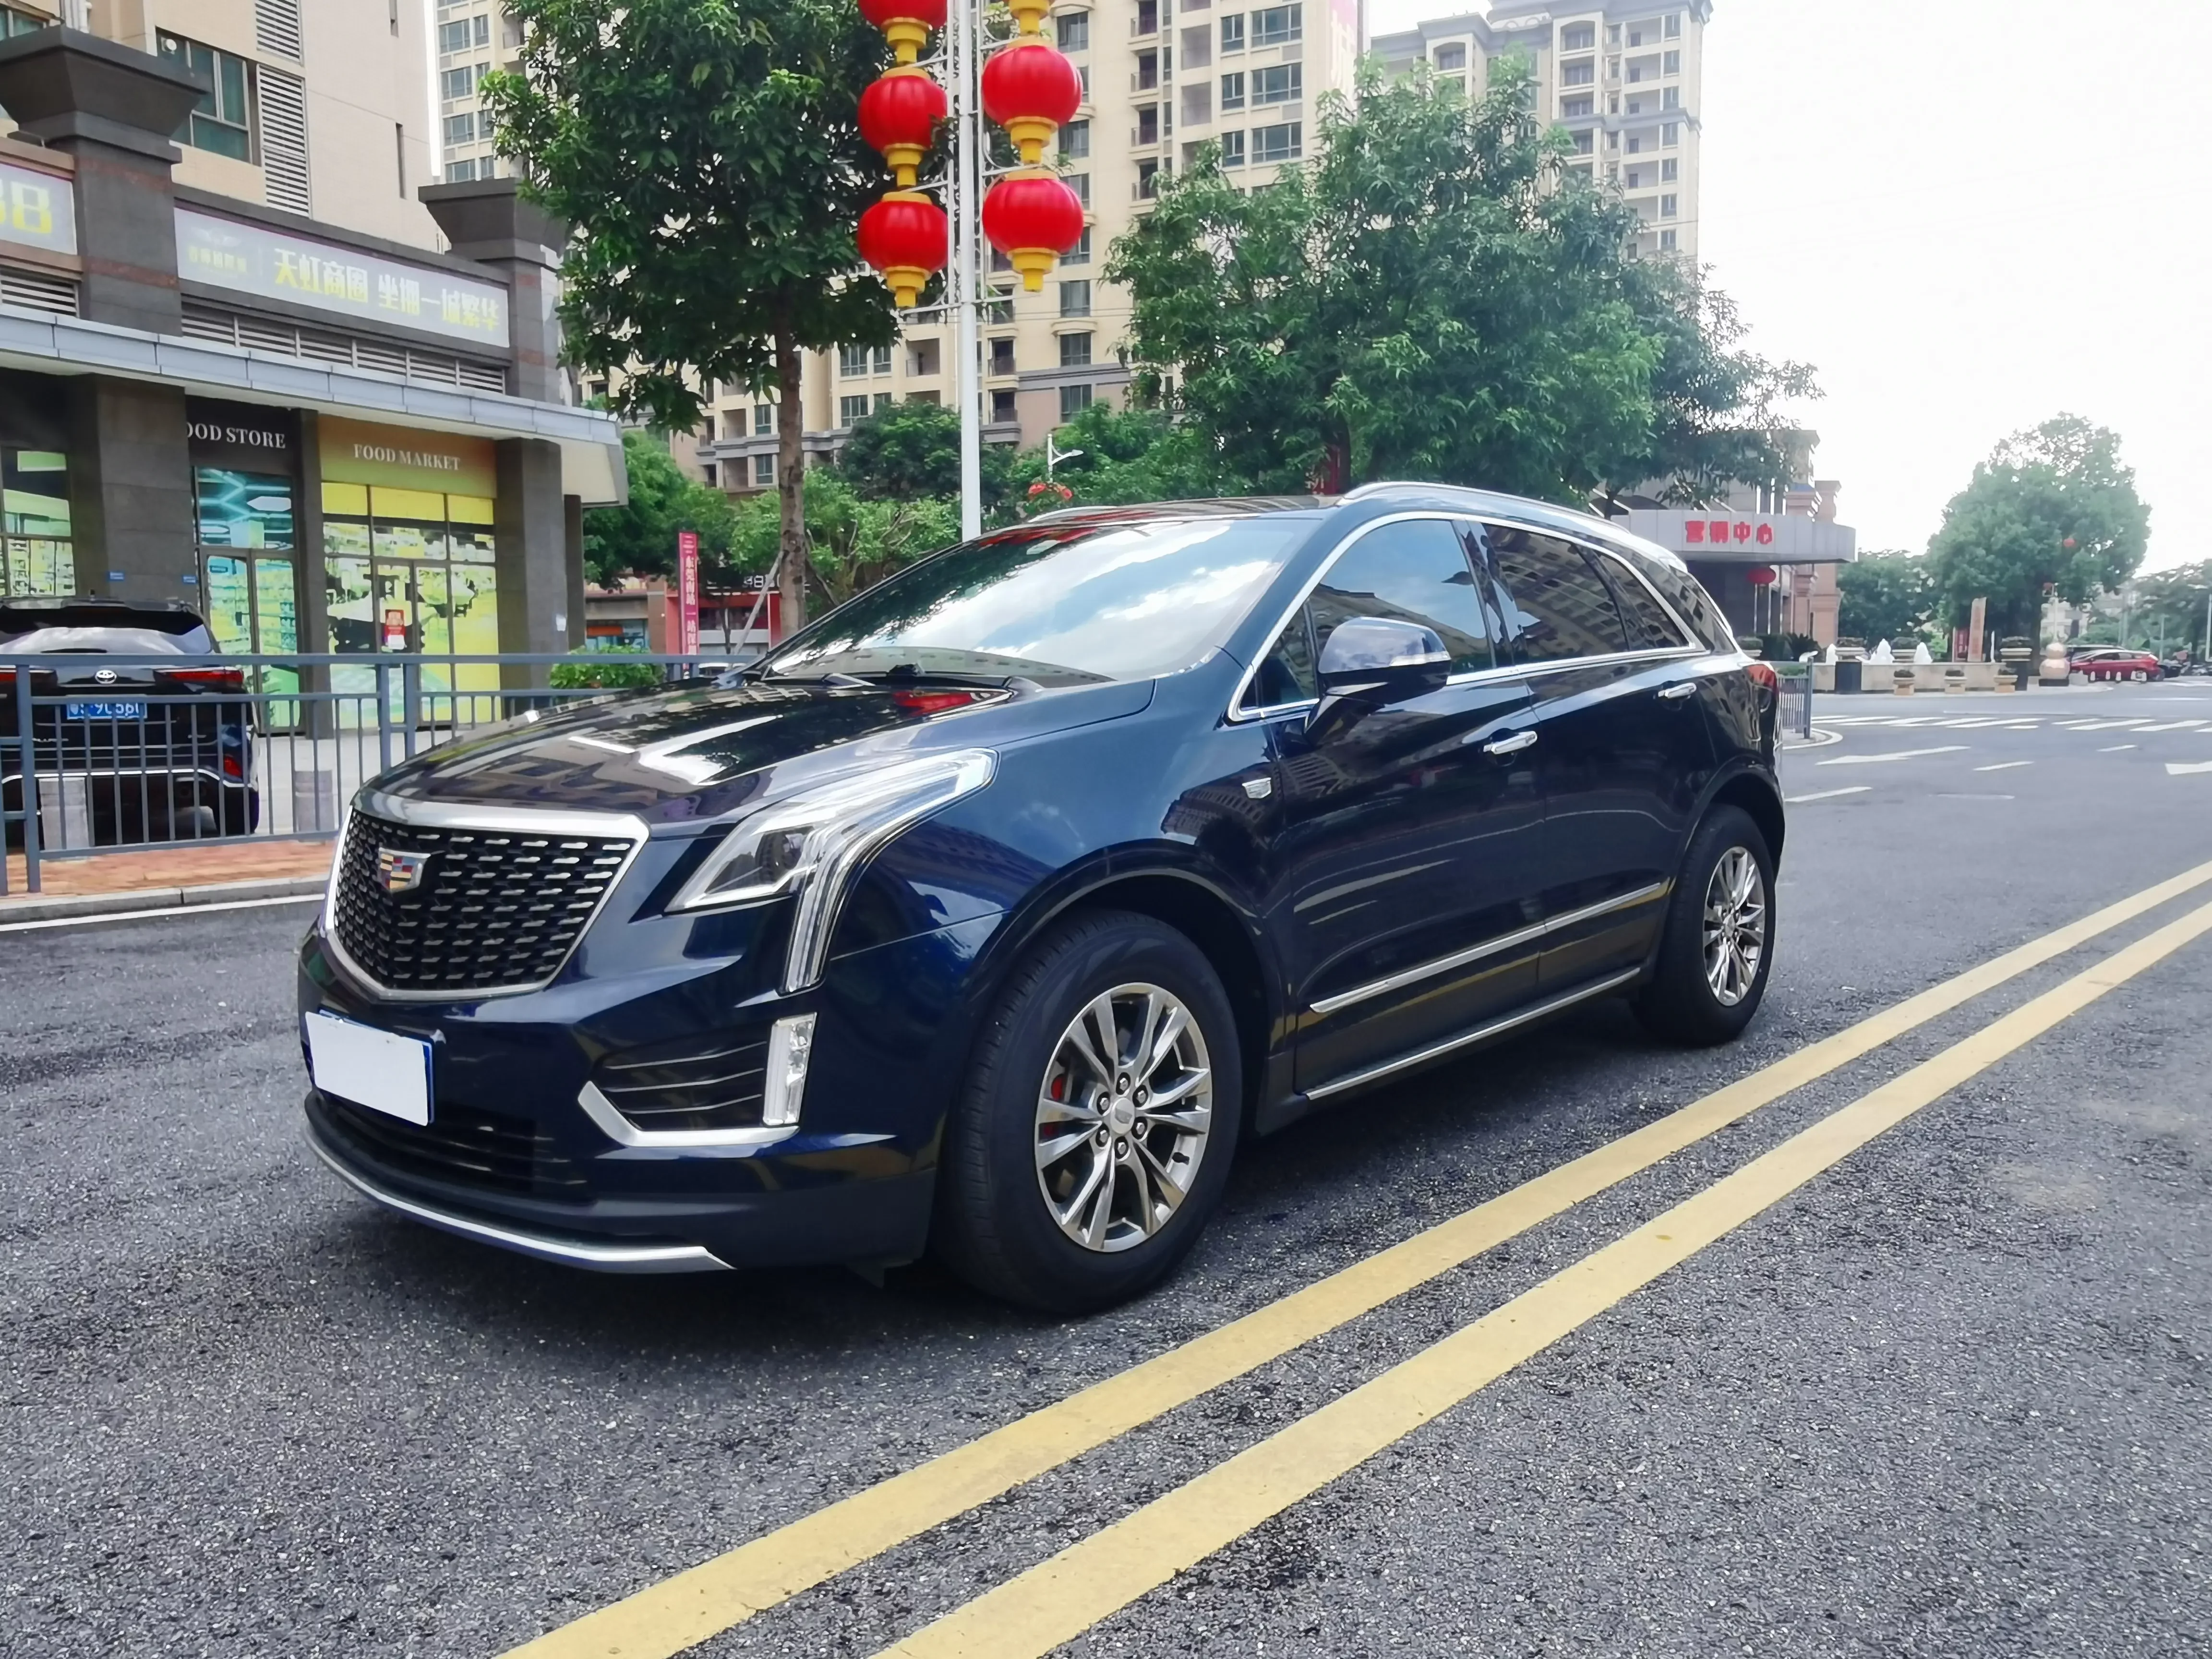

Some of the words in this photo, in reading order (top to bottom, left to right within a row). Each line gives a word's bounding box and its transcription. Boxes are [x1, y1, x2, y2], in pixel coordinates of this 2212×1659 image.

[274, 248, 369, 303] 天虹商圈
[226, 427, 286, 449] STORE
[354, 444, 396, 462] FOOD
[399, 450, 460, 470] MARKET
